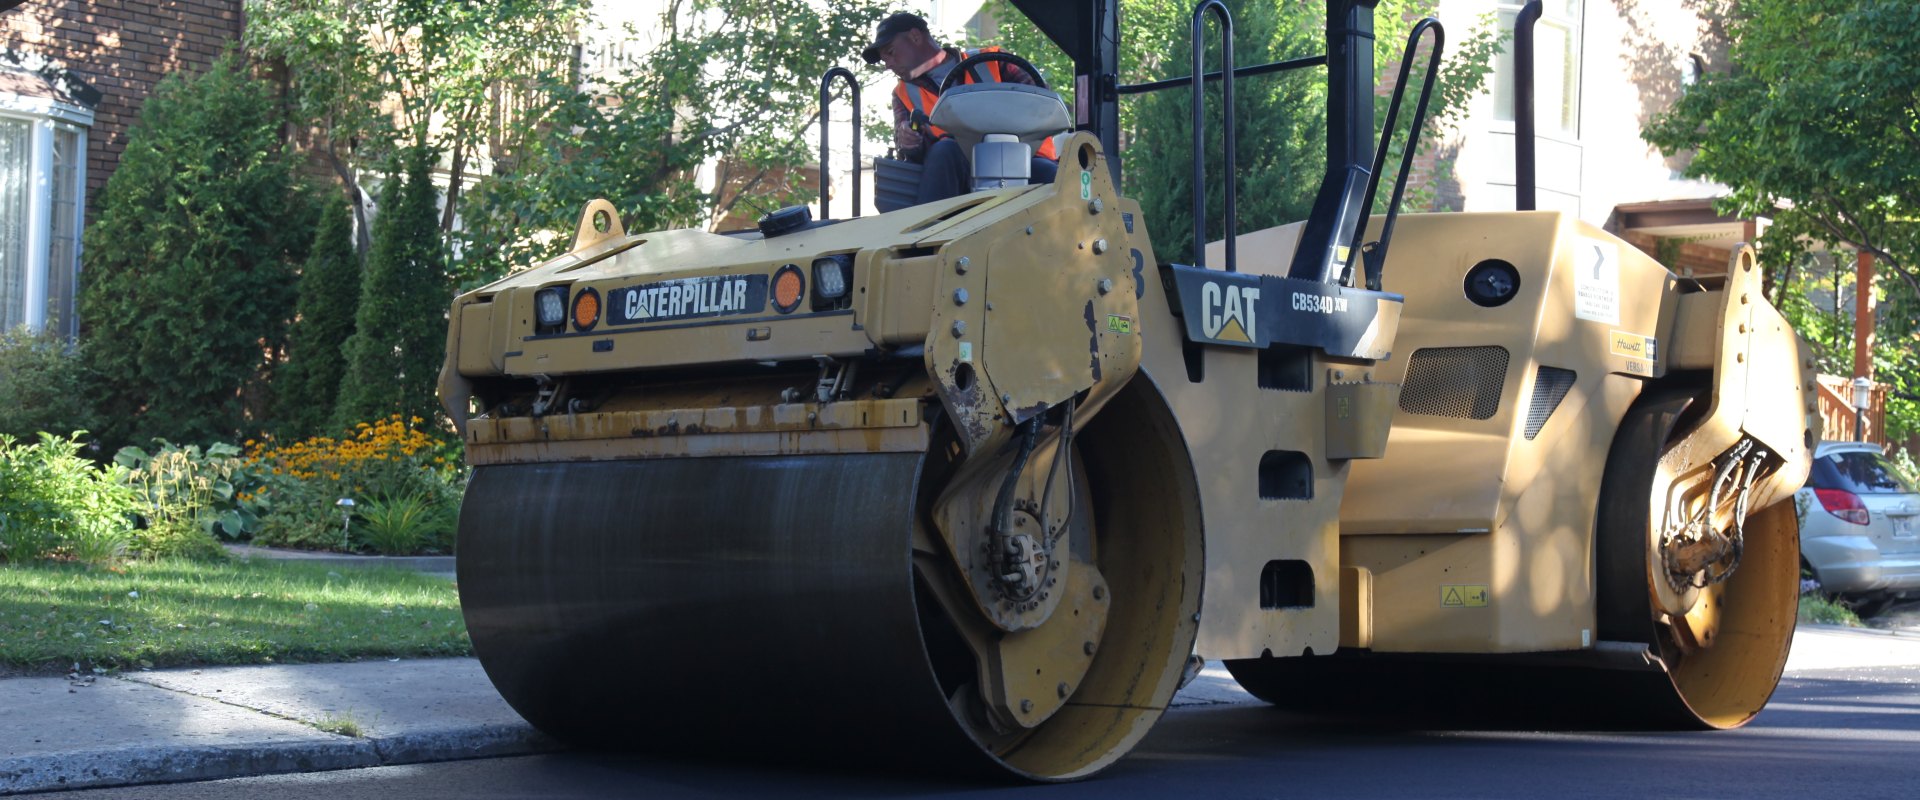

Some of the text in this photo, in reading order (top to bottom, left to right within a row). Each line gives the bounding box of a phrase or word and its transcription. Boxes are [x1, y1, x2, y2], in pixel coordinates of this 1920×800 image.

[625, 280, 747, 319] CATERPILLAR
[1201, 281, 1260, 343] CAT
[1292, 292, 1348, 314] CB534D XW
